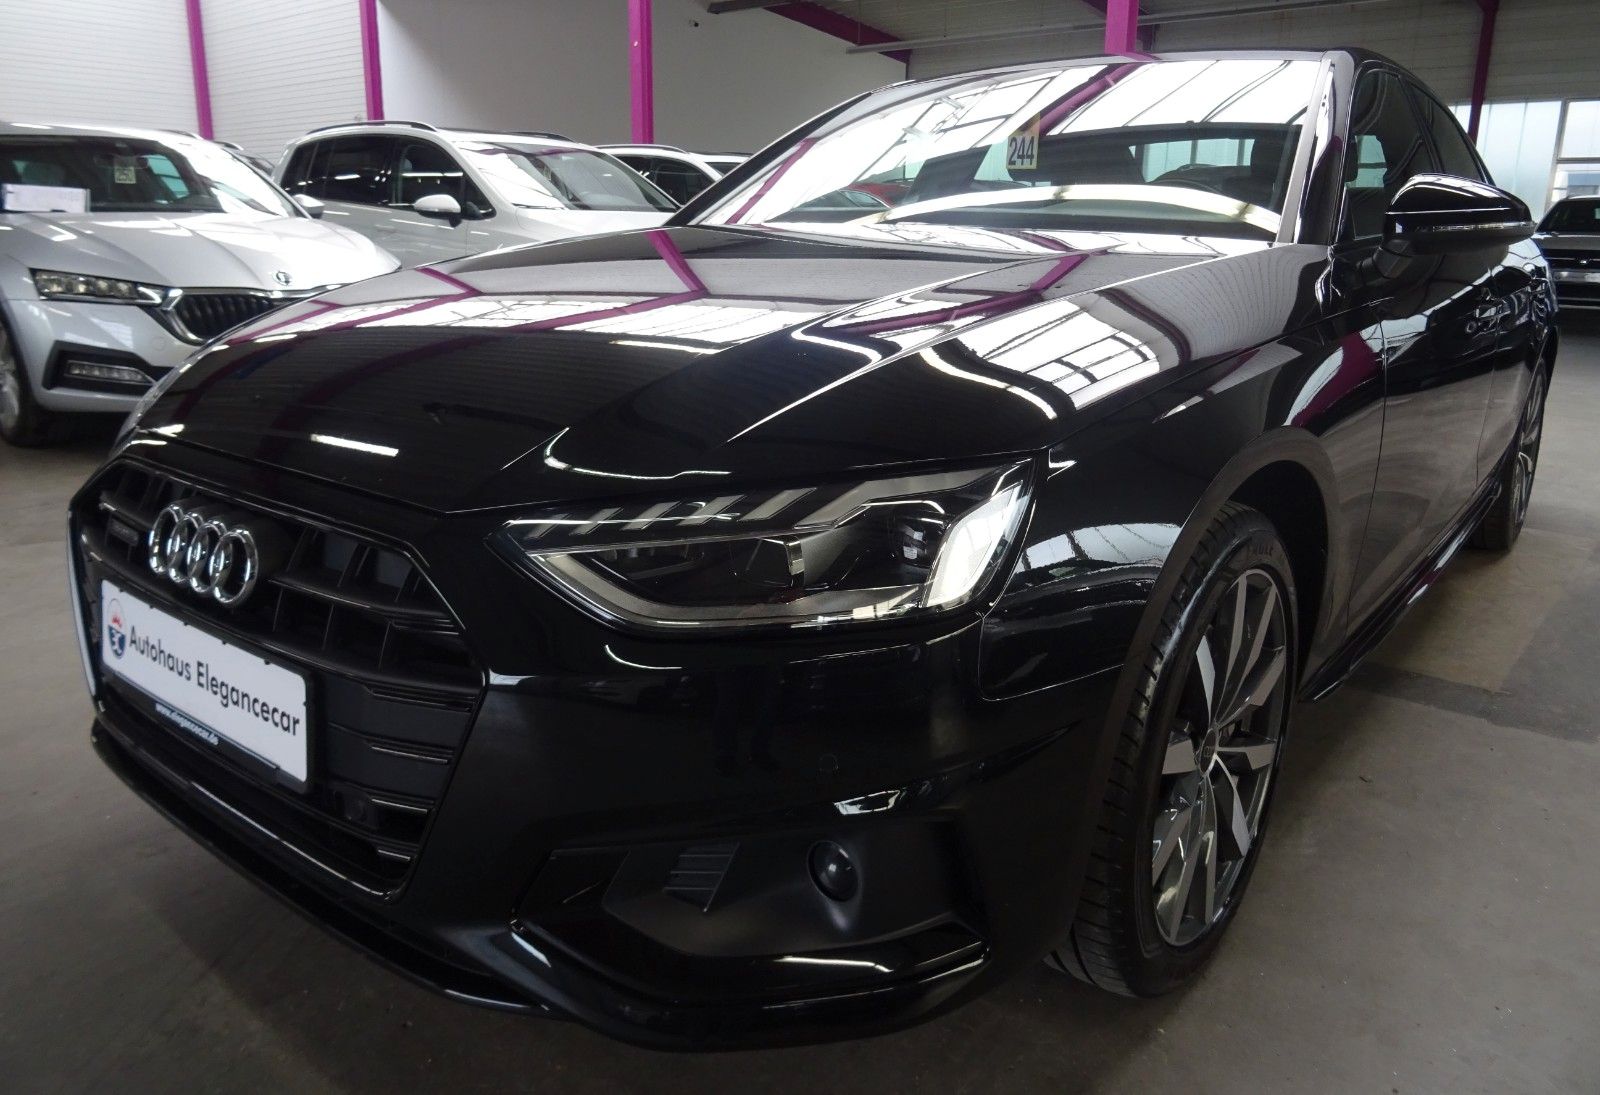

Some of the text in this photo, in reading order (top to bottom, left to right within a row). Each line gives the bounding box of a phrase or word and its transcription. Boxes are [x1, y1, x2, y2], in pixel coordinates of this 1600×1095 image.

[1008, 136, 1035, 166] 244
[129, 625, 192, 681] Autohaus
[197, 660, 300, 736] Elegancecar
